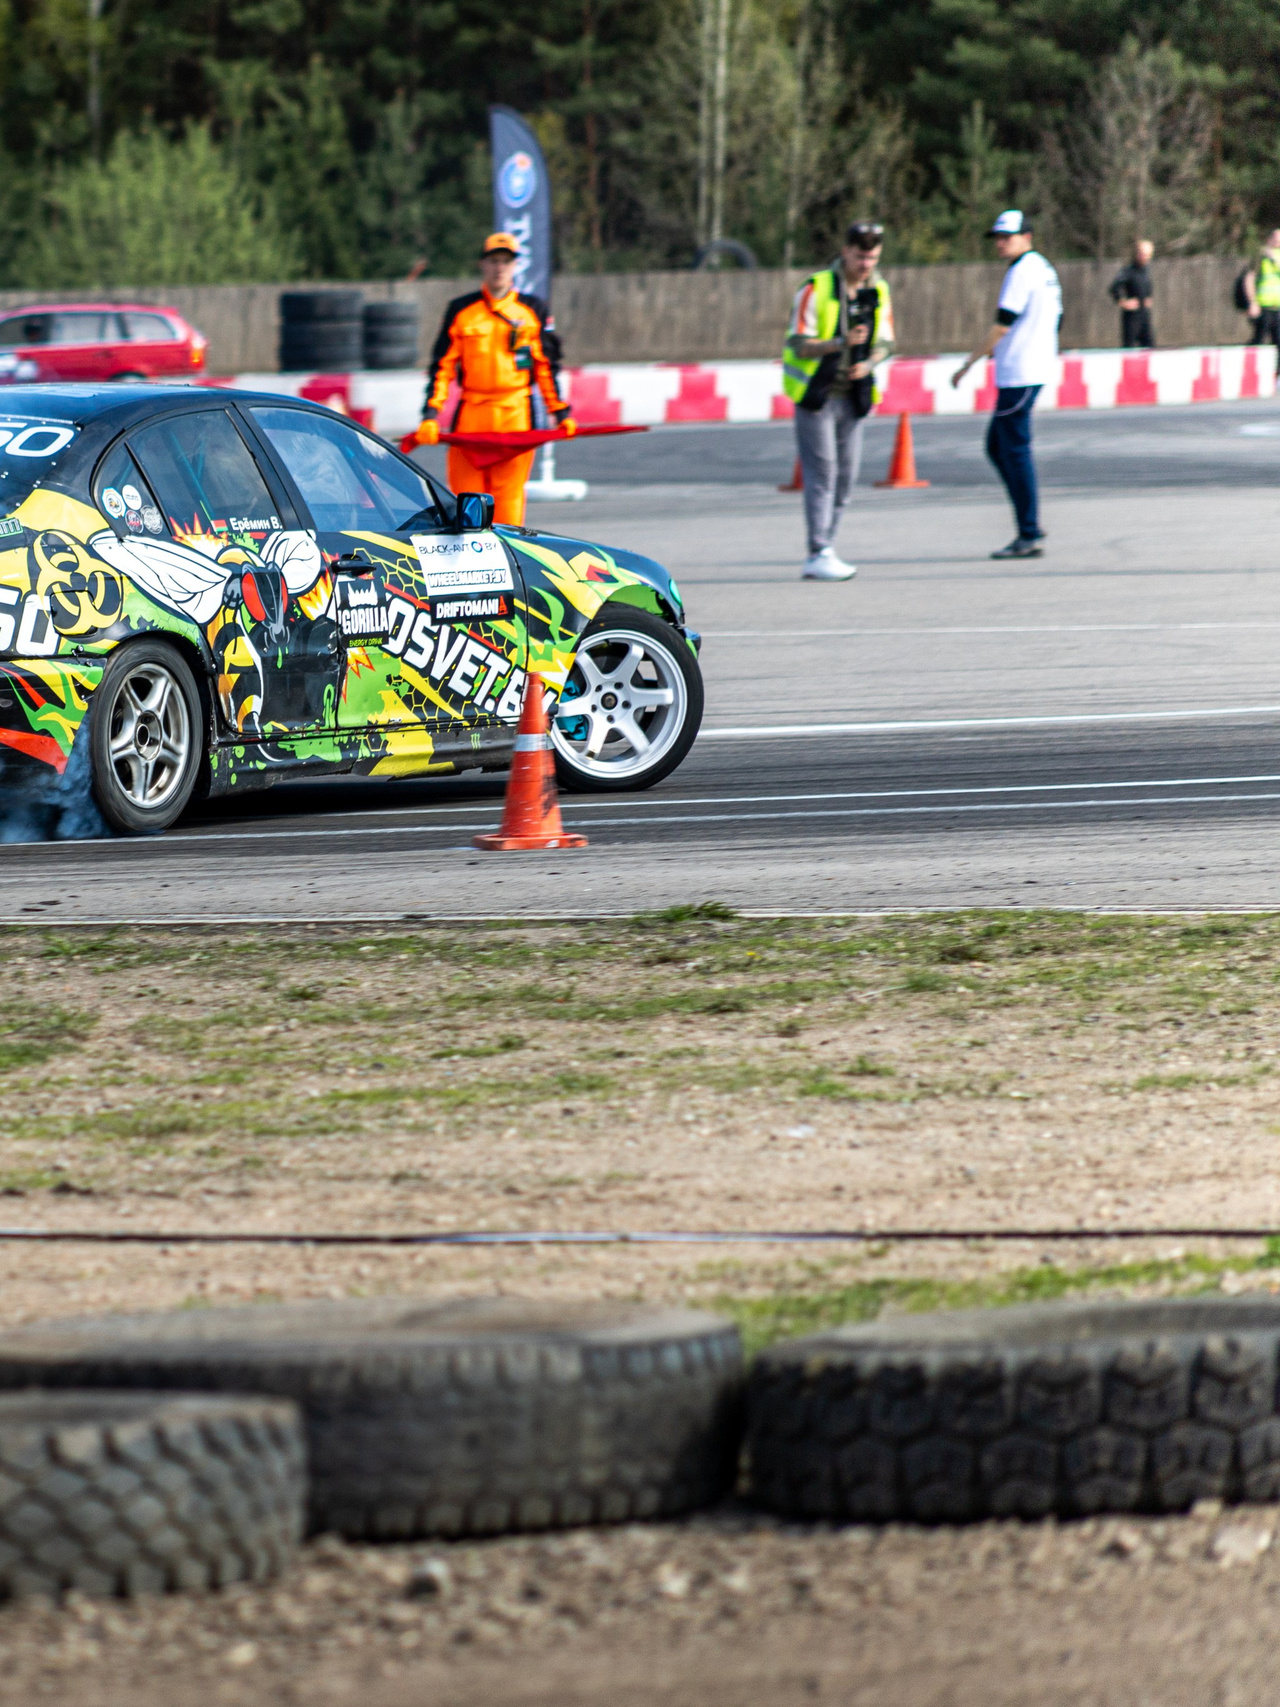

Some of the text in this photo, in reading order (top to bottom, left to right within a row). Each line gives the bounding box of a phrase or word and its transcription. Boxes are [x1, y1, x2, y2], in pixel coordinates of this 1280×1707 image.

[229, 516, 271, 533] Ерёмин
[435, 595, 508, 620] DRIFTOMANIA
[342, 606, 389, 635] GORILLA
[349, 637, 384, 647] ENERGY DRINK
